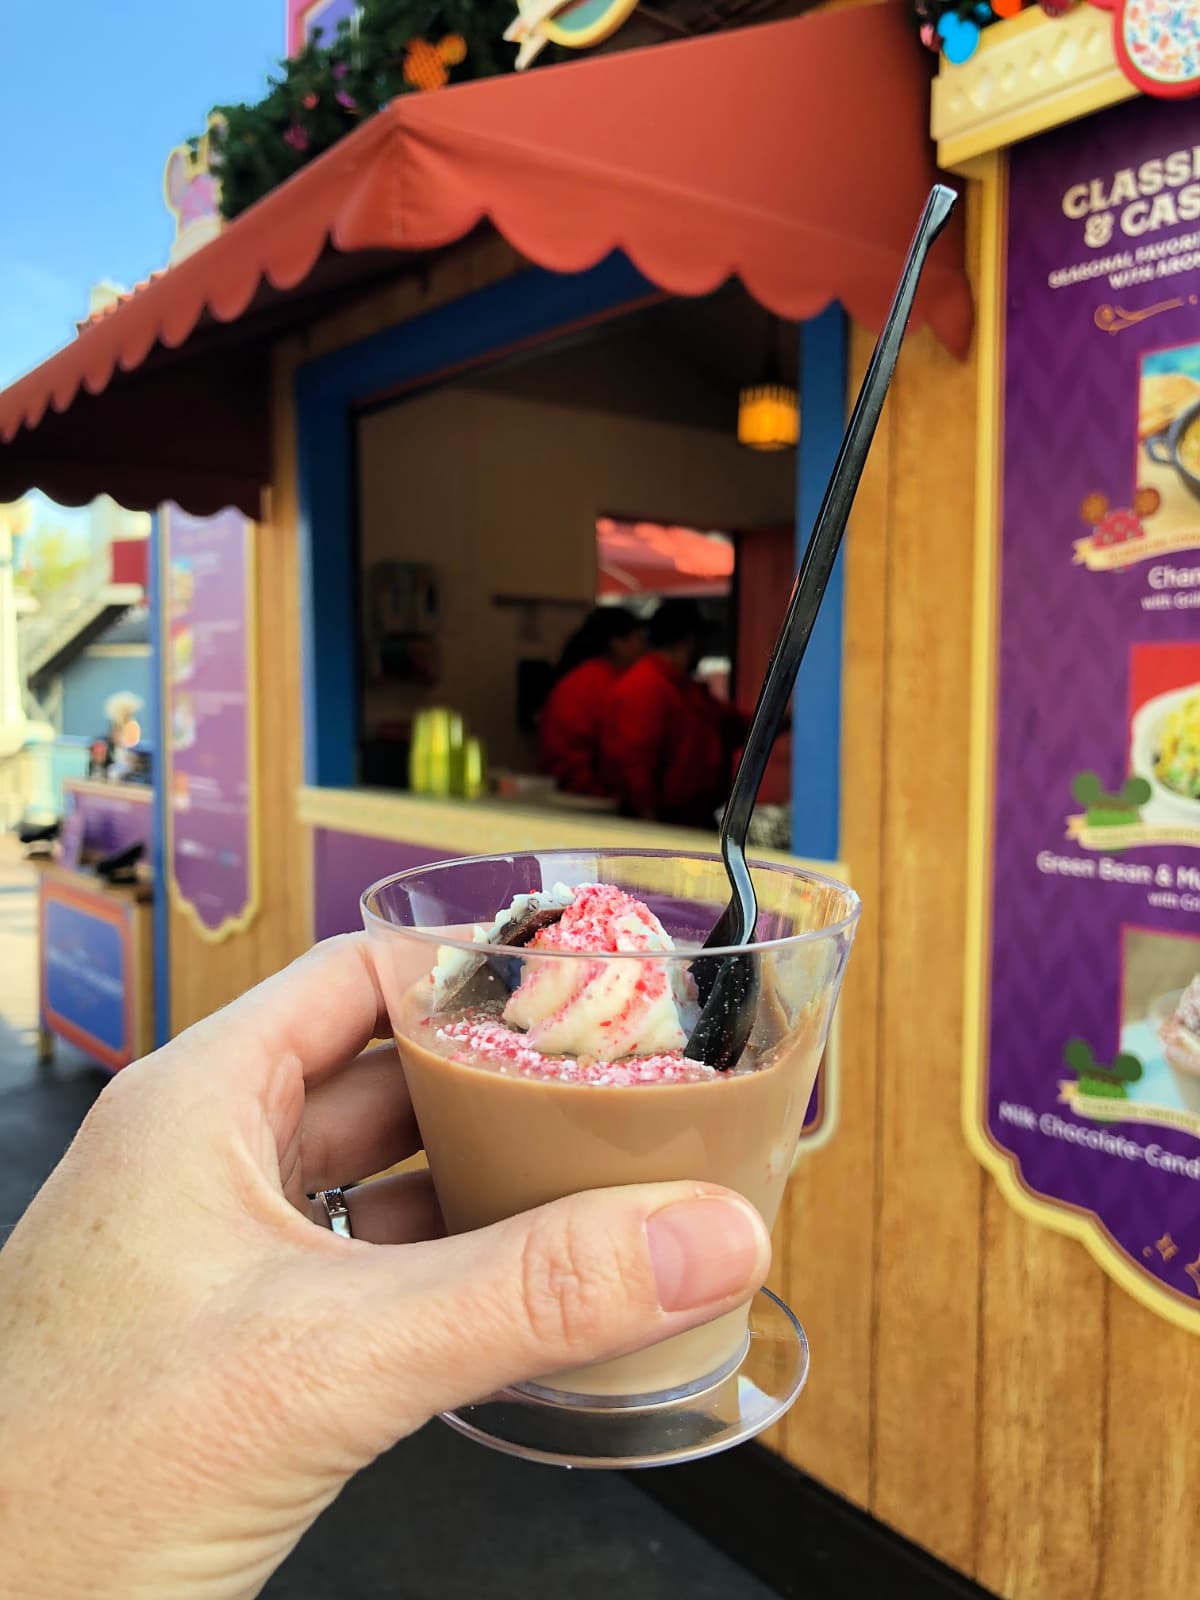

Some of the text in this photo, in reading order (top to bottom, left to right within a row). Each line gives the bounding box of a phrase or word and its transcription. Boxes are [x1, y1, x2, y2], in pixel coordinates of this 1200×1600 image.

[1084, 183, 1200, 248] & CAS
[1108, 263, 1155, 290] WITH
[1140, 593, 1172, 611] with
[1036, 850, 1096, 879] Green
[1099, 856, 1153, 886] Bean
[1155, 863, 1174, 888] &
[1147, 891, 1179, 910] with
[999, 1101, 1038, 1132] Milk
